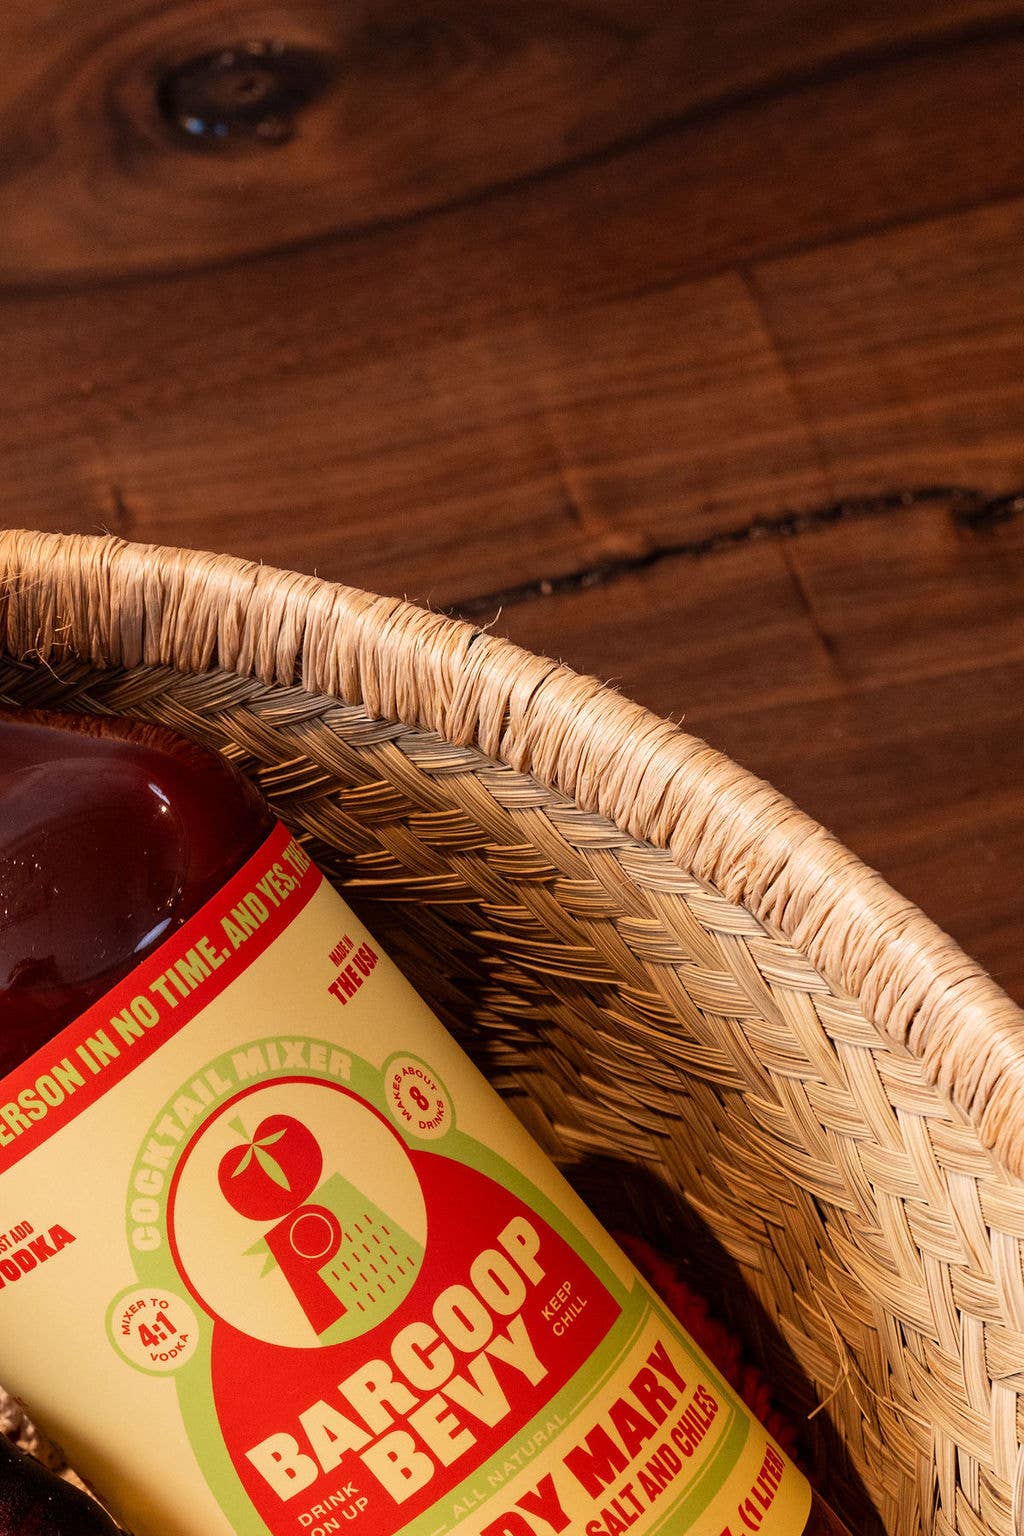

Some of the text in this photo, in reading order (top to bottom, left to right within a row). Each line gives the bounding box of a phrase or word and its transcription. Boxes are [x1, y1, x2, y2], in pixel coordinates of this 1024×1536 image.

[75, 1029, 120, 1075] IN
[109, 995, 160, 1046] NO
[149, 936, 232, 1009] TIME.
[220, 892, 269, 950] AND
[256, 863, 302, 907] YES,
[328, 934, 355, 967] MADE IN
[327, 942, 379, 1006] THE USA
[393, 1066, 437, 1121] MAKES ABOUT
[409, 1086, 429, 1111] 8
[418, 1100, 445, 1130] DRINKS
[130, 1041, 353, 1251] COCKTAIL MIXER
[9, 1220, 34, 1244] ADD
[121, 1298, 169, 1335] MIXER TO
[540, 1280, 573, 1321] KEEP
[552, 1296, 588, 1337] CHILL
[138, 1311, 177, 1347] 4:1
[150, 1333, 189, 1361] VODKA
[244, 1215, 546, 1502] BARCOOP
[359, 1313, 549, 1505] BEVY
[562, 1339, 687, 1501] MARY
[636, 1443, 683, 1504] AND
[670, 1384, 719, 1458] CHILES
[450, 1413, 569, 1520] ALL NATURAL
[750, 1441, 786, 1512] LITER)
[297, 1481, 360, 1528] DRINK
[344, 1496, 370, 1525] UP
[737, 1496, 764, 1532] (1
